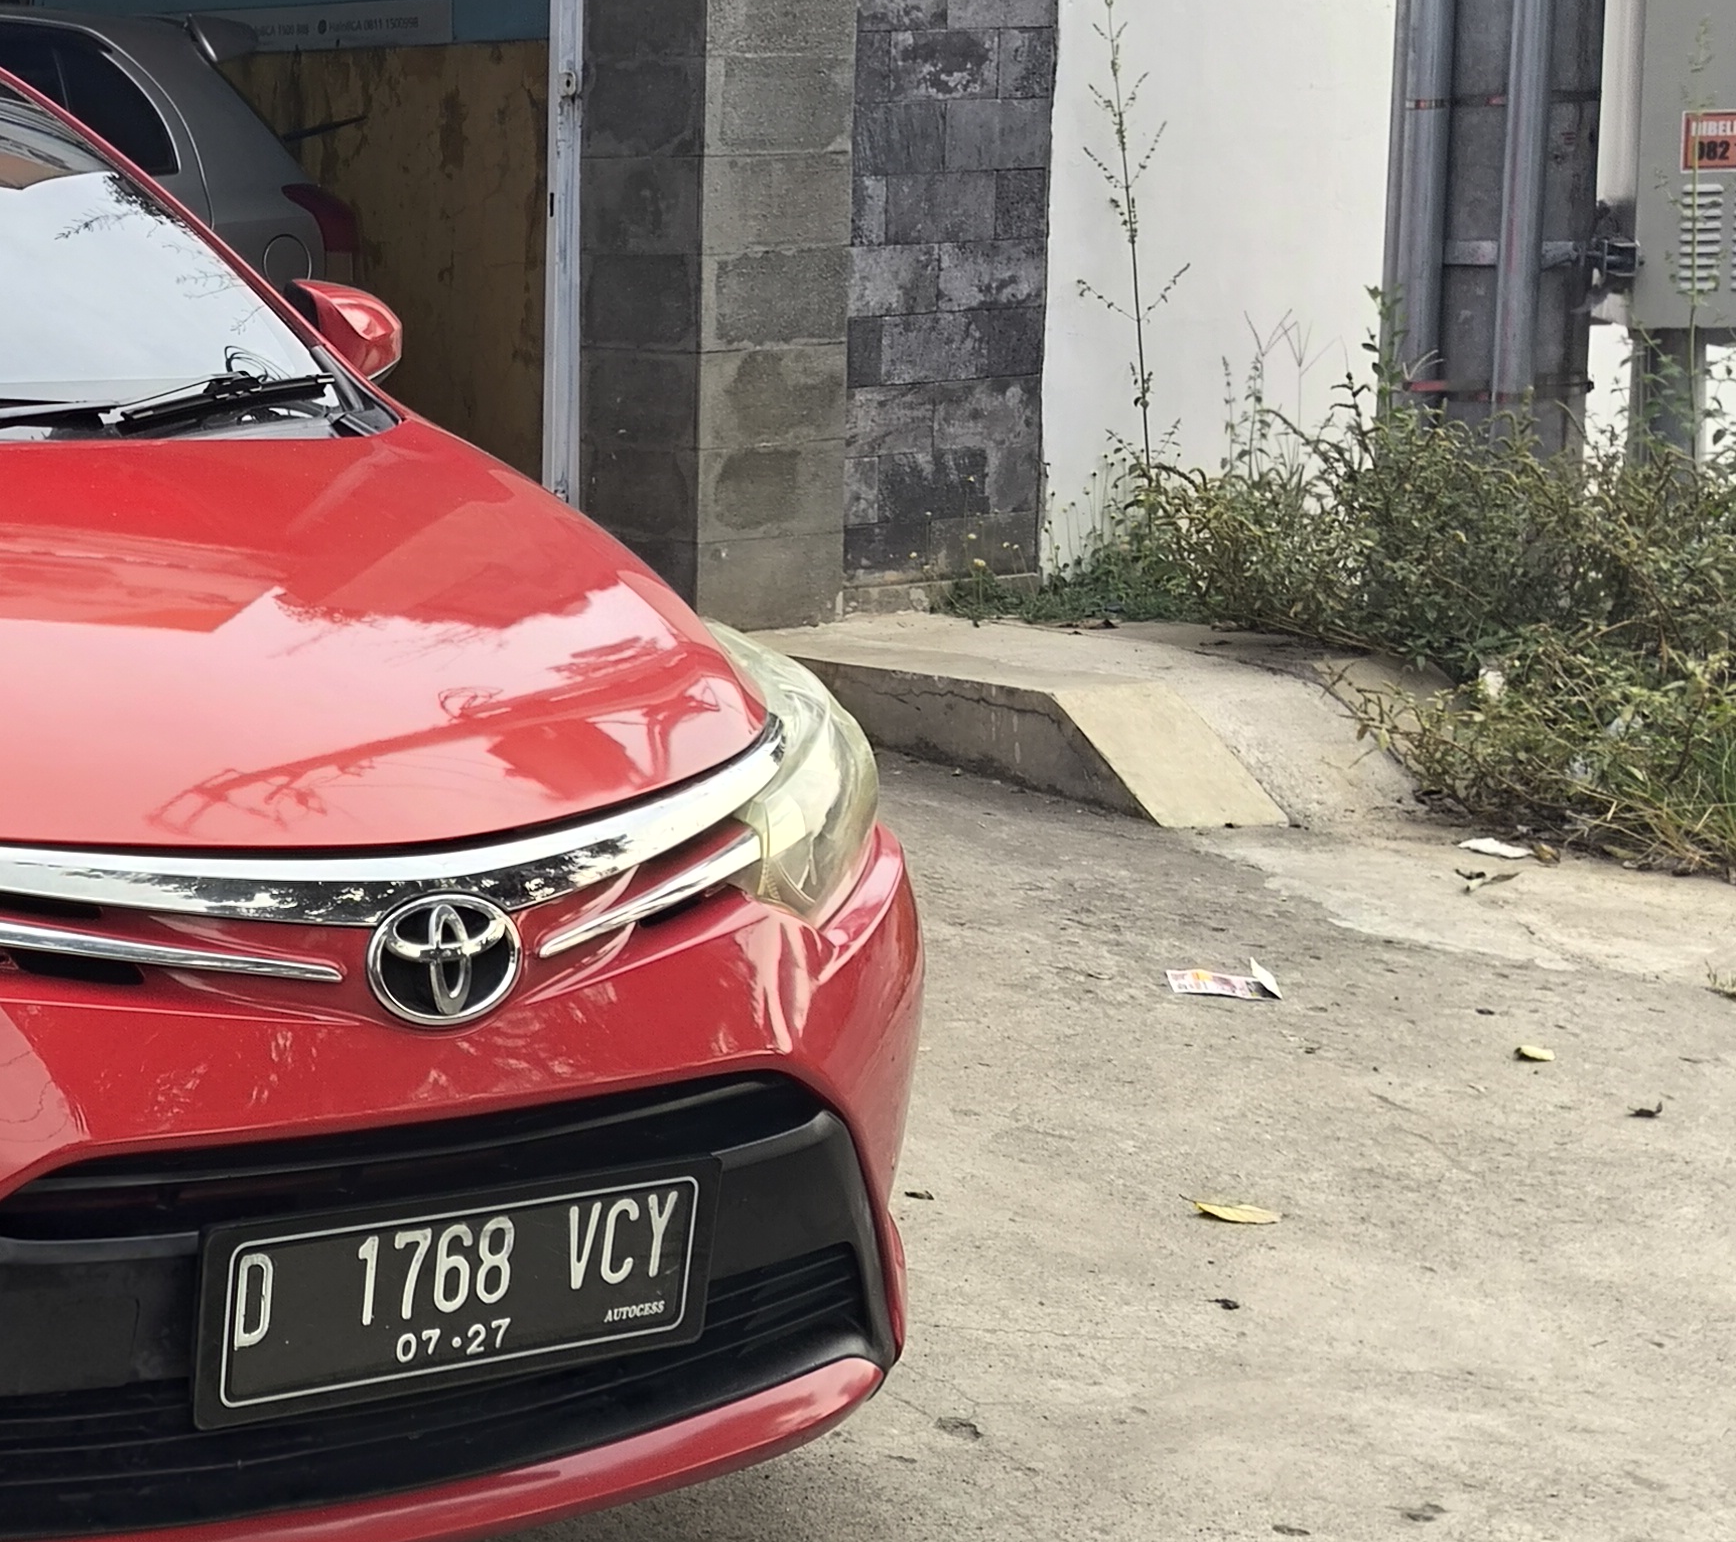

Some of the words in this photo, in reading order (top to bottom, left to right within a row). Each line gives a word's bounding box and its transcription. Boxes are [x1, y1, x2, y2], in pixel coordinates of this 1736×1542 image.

[233, 1252, 275, 1350] D
[357, 1214, 516, 1326] 1768
[568, 1190, 678, 1290] VCY
[603, 1299, 665, 1323] AUTOCESS
